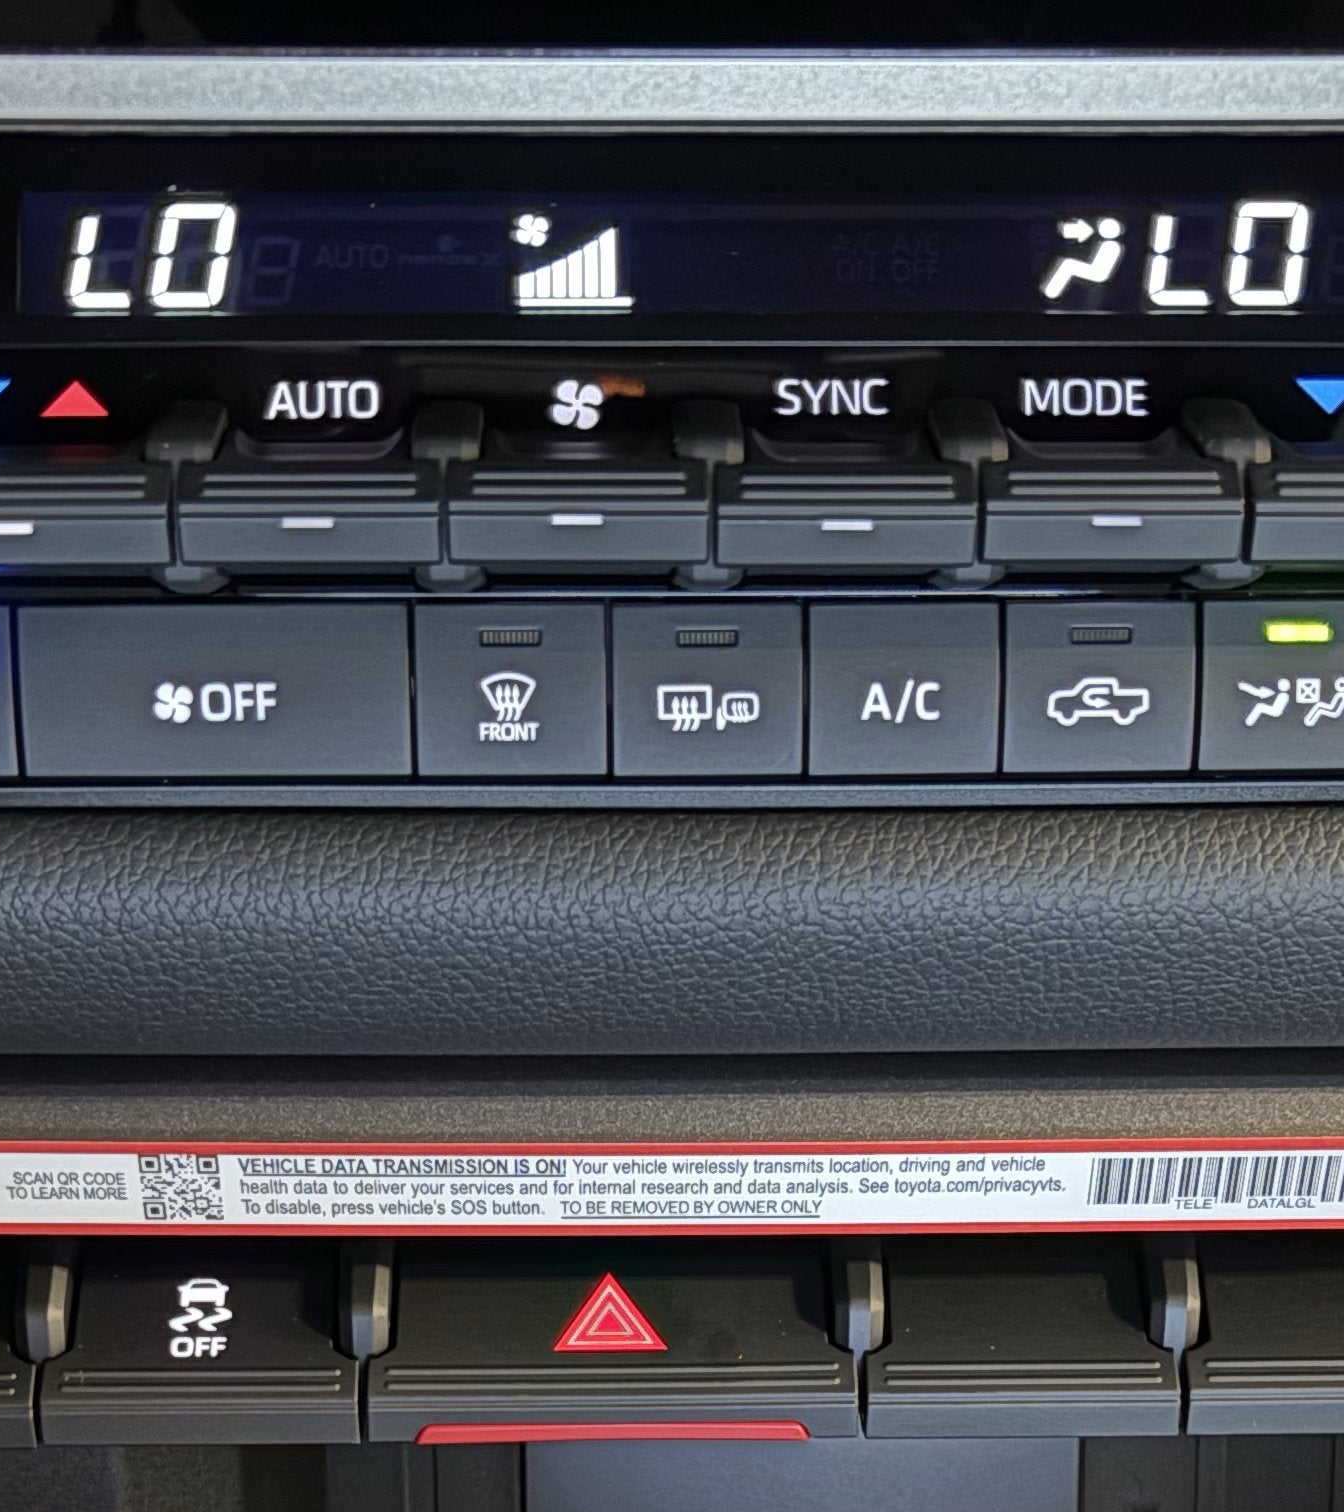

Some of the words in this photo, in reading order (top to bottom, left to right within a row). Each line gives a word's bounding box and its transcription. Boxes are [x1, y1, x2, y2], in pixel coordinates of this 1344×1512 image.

[68, 203, 237, 307] LO
[1148, 202, 1310, 306] LO
[265, 380, 380, 420] AUTO
[775, 378, 889, 416] SYNC
[1022, 378, 1149, 417] MODE
[200, 682, 277, 722] OFF
[860, 678, 941, 724] A/C
[478, 722, 540, 742] FRONT
[238, 1158, 316, 1174] VEHICLE
[321, 1158, 369, 1174] DATA
[372, 1158, 508, 1174] TRANSMISSION
[514, 1158, 530, 1174] IS
[535, 1158, 567, 1174] ON!
[572, 1159, 608, 1174] Your
[613, 1159, 667, 1174] vehicle
[672, 1159, 748, 1177] wirelessly
[753, 1158, 824, 1174] transmits
[829, 1158, 894, 1175] location,
[899, 1157, 950, 1176] driving
[956, 1156, 985, 1172] and
[991, 1156, 1046, 1172] vehicle
[12, 1172, 54, 1185] SCAN
[57, 1172, 80, 1186] QR
[83, 1172, 126, 1186] CODE
[240, 1179, 288, 1194] health
[293, 1179, 328, 1194] data
[333, 1181, 348, 1194] to
[354, 1180, 406, 1195] deliver
[411, 1183, 445, 1198] your
[450, 1180, 514, 1195] services
[519, 1180, 548, 1195] and
[553, 1180, 574, 1195] for
[578, 1179, 636, 1195] internal
[641, 1179, 708, 1195] research
[714, 1179, 742, 1194] and
[747, 1179, 781, 1194] data
[786, 1178, 853, 1197] analysis.
[858, 1178, 889, 1194] See
[894, 1177, 1067, 1197] toyota.com/privacyvts.
[6, 1186, 27, 1200] TO
[31, 1186, 80, 1200] LEARN
[83, 1187, 128, 1200] MORE
[1174, 1199, 1213, 1210] TELE
[1247, 1197, 1316, 1209] DATALGL
[241, 1199, 261, 1214] To
[265, 1199, 326, 1217] disable,
[331, 1203, 374, 1218] press
[379, 1199, 446, 1215] vehicle's
[451, 1200, 487, 1215] SOS
[492, 1200, 546, 1215] button.
[560, 1201, 582, 1214] TO
[586, 1201, 606, 1214] BE
[611, 1201, 690, 1214] REMOVED
[693, 1200, 715, 1214] BY
[717, 1200, 778, 1214] OWNER
[781, 1200, 823, 1213] ONLY
[169, 1336, 228, 1358] OFF
